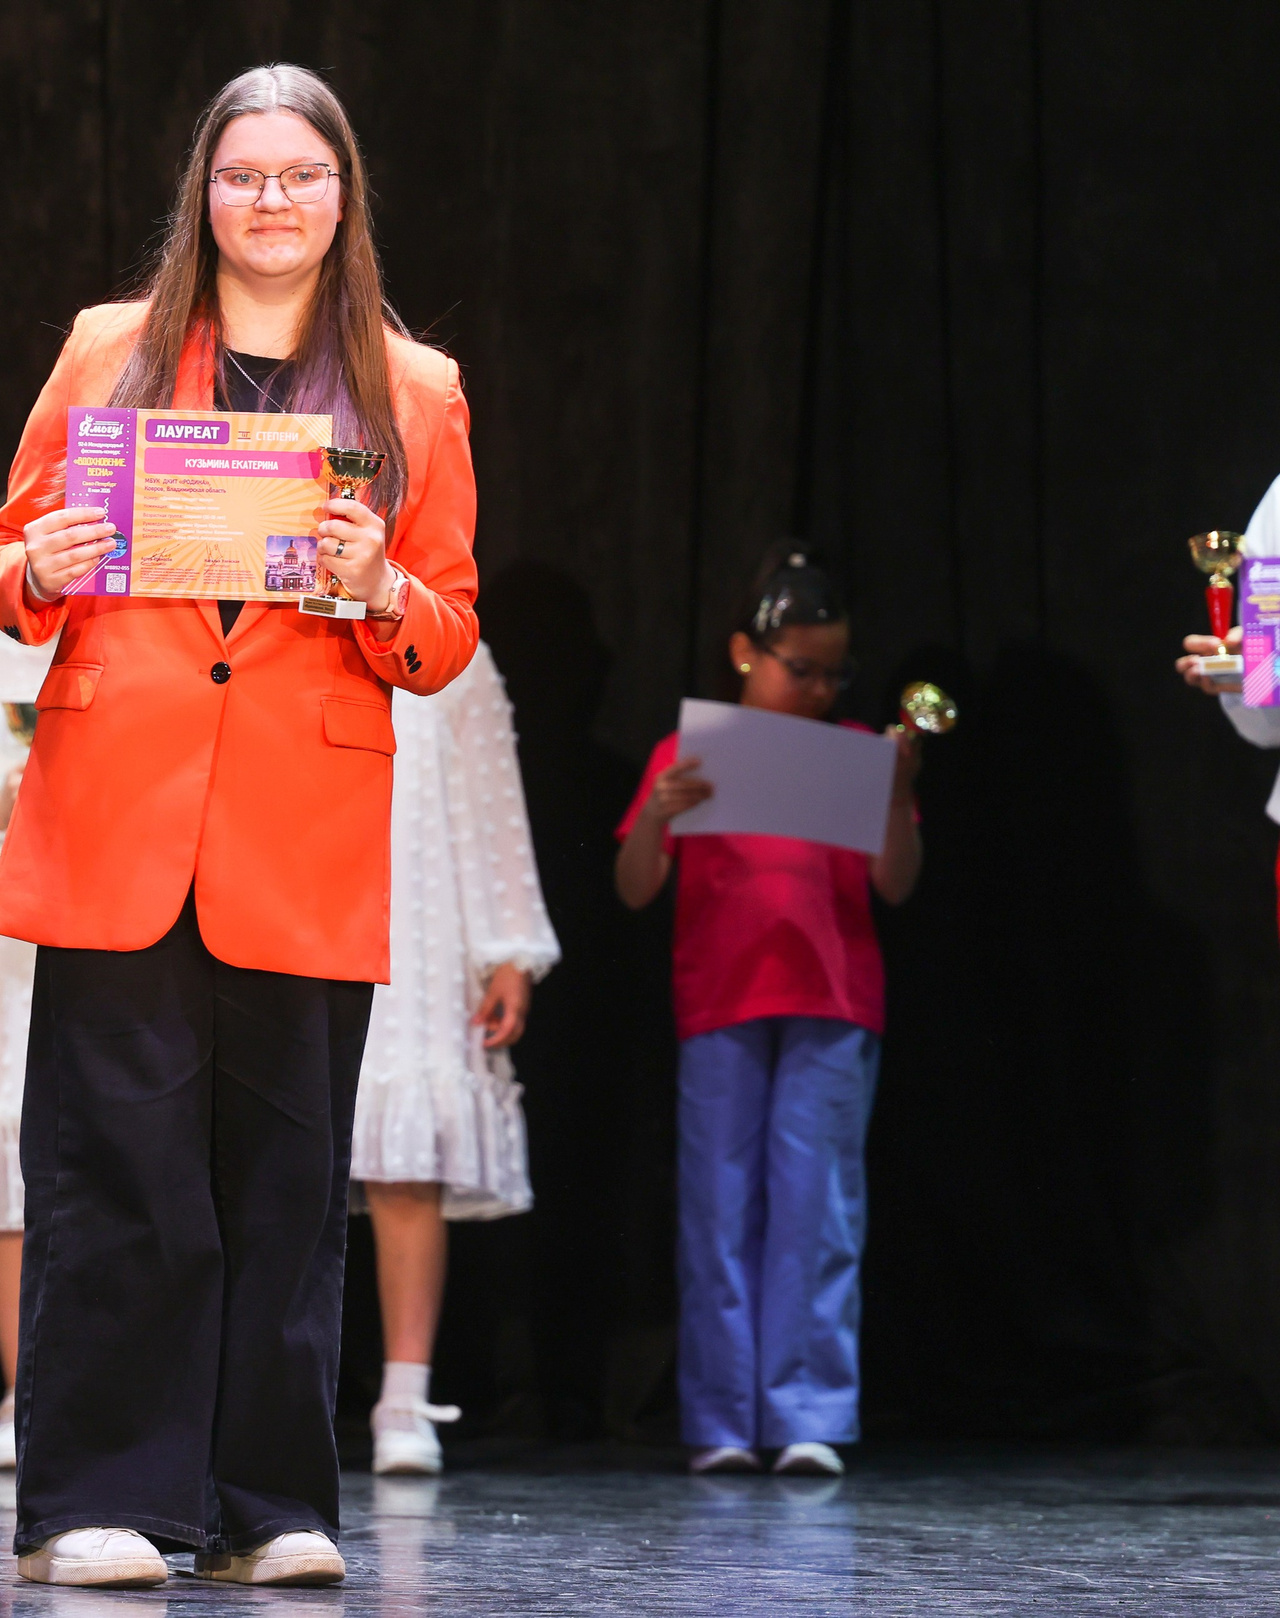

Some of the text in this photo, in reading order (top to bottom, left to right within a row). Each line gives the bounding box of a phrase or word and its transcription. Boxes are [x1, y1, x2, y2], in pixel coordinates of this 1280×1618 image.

[154, 424, 220, 440] ЛАУРЕАТ
[255, 431, 299, 442] СТЕПЕНИ
[185, 458, 279, 471] КУЗЬМИНА ЕКАТЕРИНА
